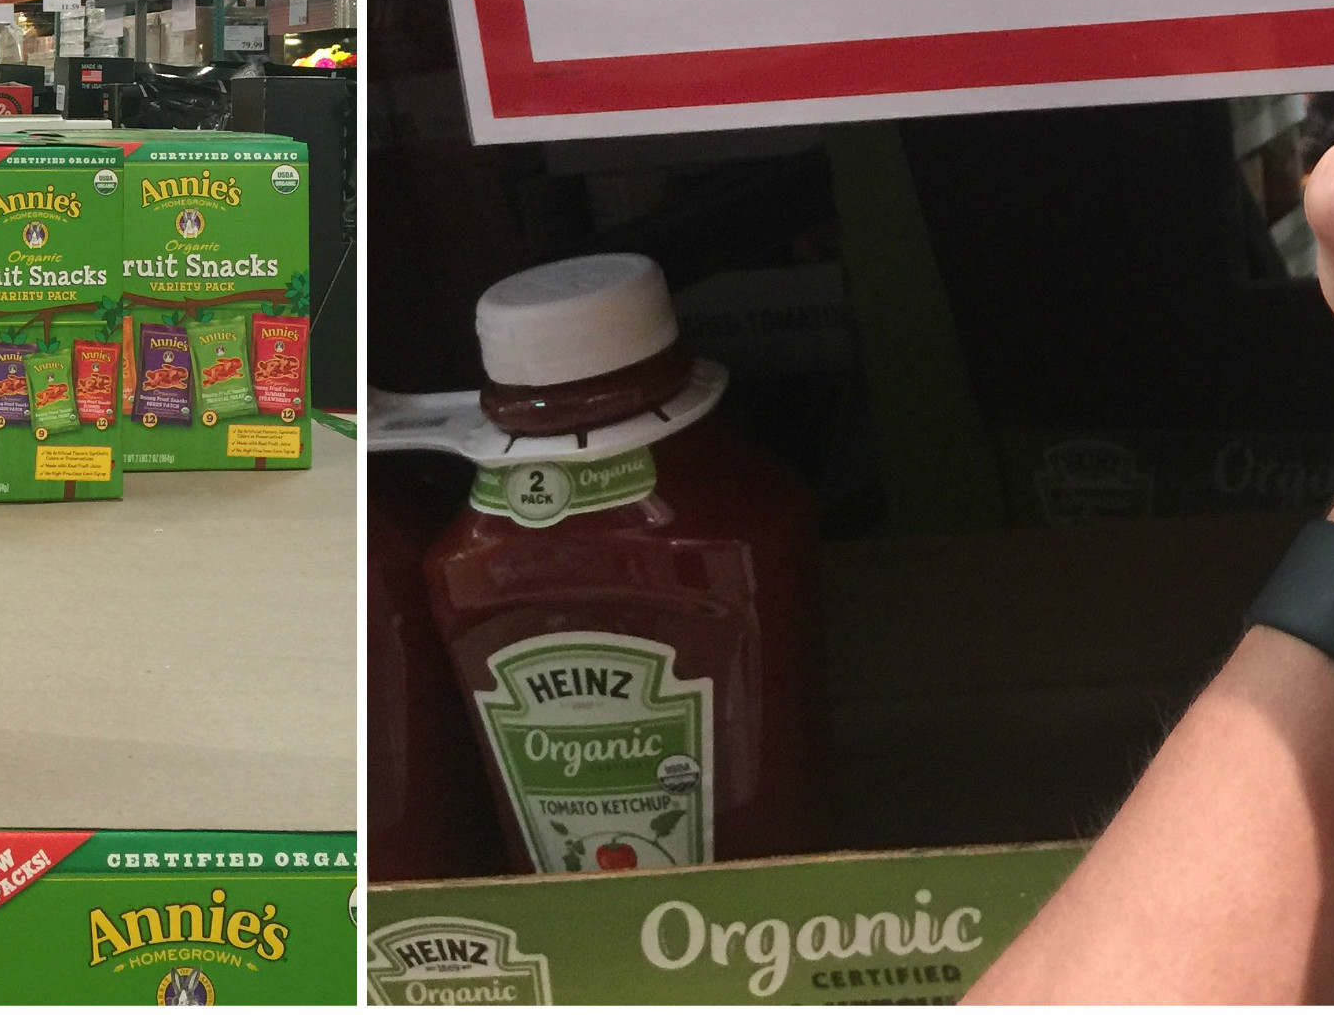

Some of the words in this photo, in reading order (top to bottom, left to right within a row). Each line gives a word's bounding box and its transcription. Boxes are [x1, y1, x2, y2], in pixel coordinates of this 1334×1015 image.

[241, 41, 263, 49] 79.99
[29, 267, 108, 287] Snacks
[525, 667, 634, 704] HEINZ
[524, 727, 663, 777] Organic
[639, 888, 985, 998] Organic
[810, 964, 963, 989] CERTIFIED
